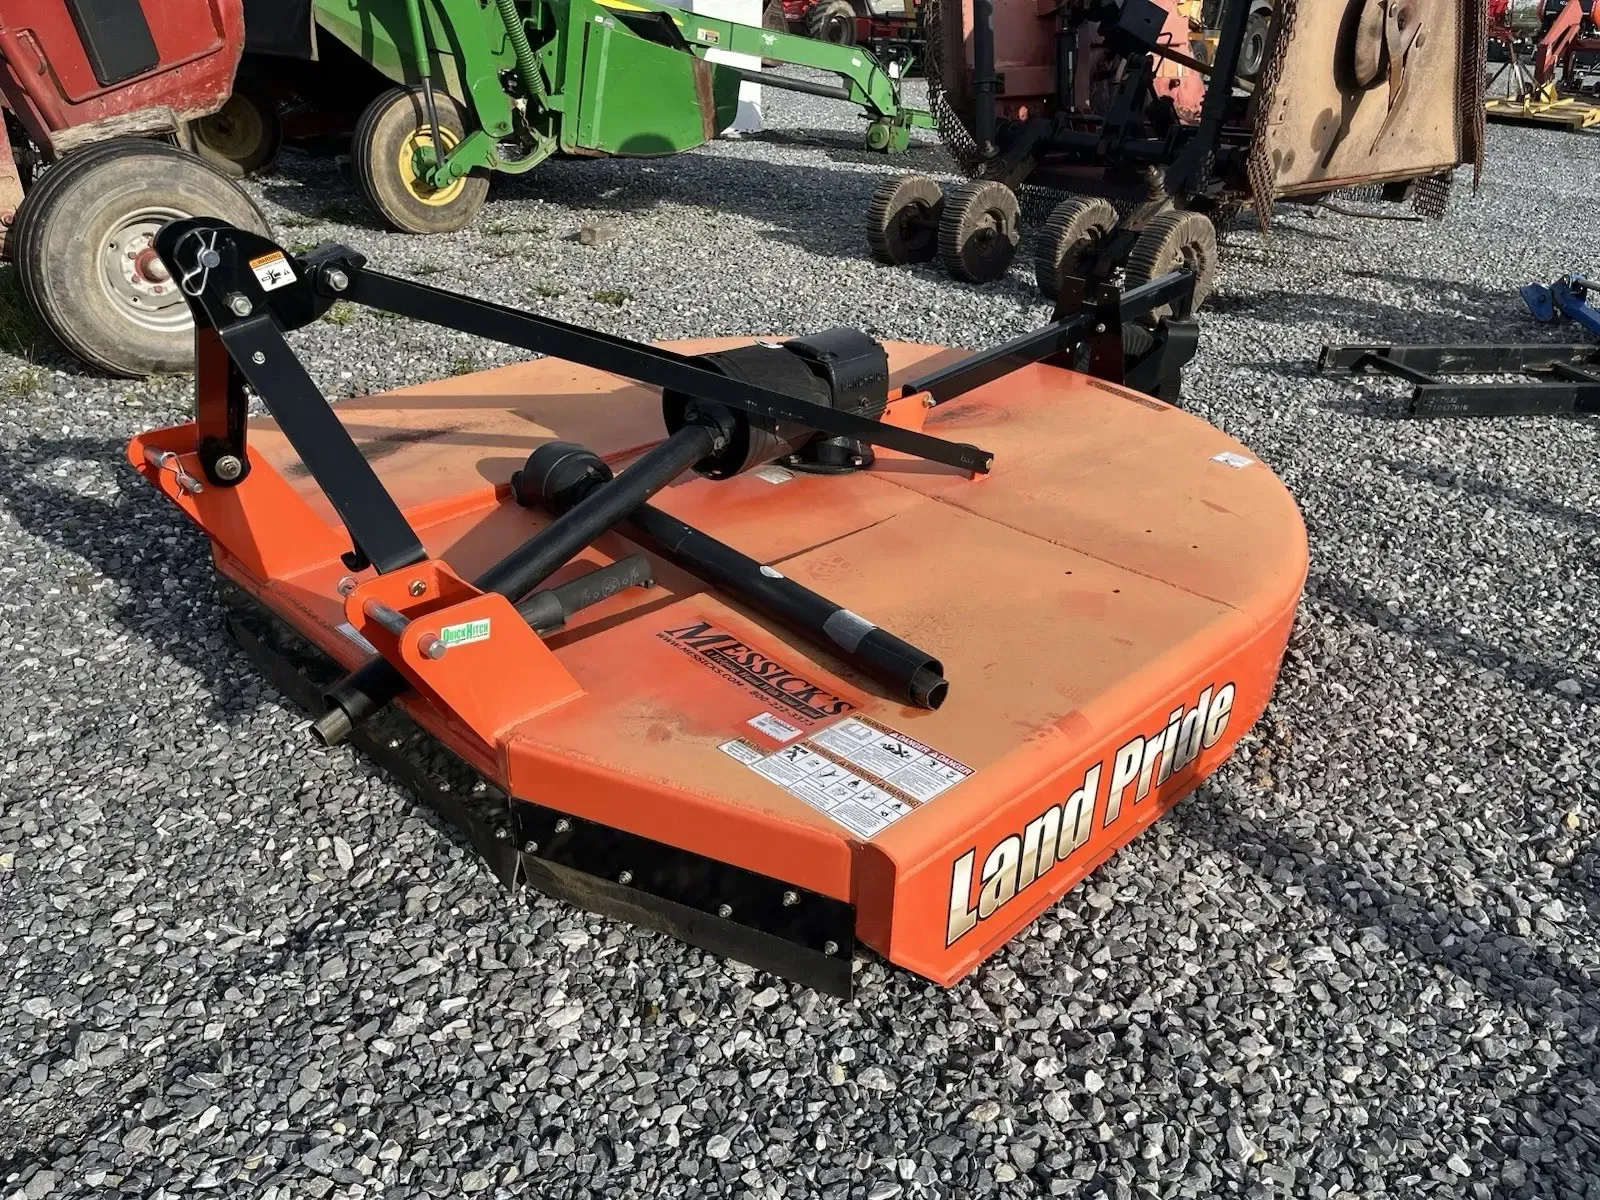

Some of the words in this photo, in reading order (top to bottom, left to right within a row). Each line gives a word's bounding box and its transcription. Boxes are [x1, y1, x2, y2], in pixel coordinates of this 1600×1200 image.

[257, 252, 282, 265] WARNING
[664, 621, 857, 715] MESSICK'S
[655, 632, 745, 687] WWW.MESSICKS.COM
[749, 690, 815, 726] 800-222-3373
[862, 718, 892, 734] WARNING
[807, 743, 838, 762] WARNING
[899, 734, 931, 753] DANGER
[844, 762, 878, 782] WARNING
[938, 754, 973, 775] DANGER
[885, 784, 920, 807] WARNING
[945, 760, 1103, 949] Land
[1103, 682, 1236, 829] Pride
